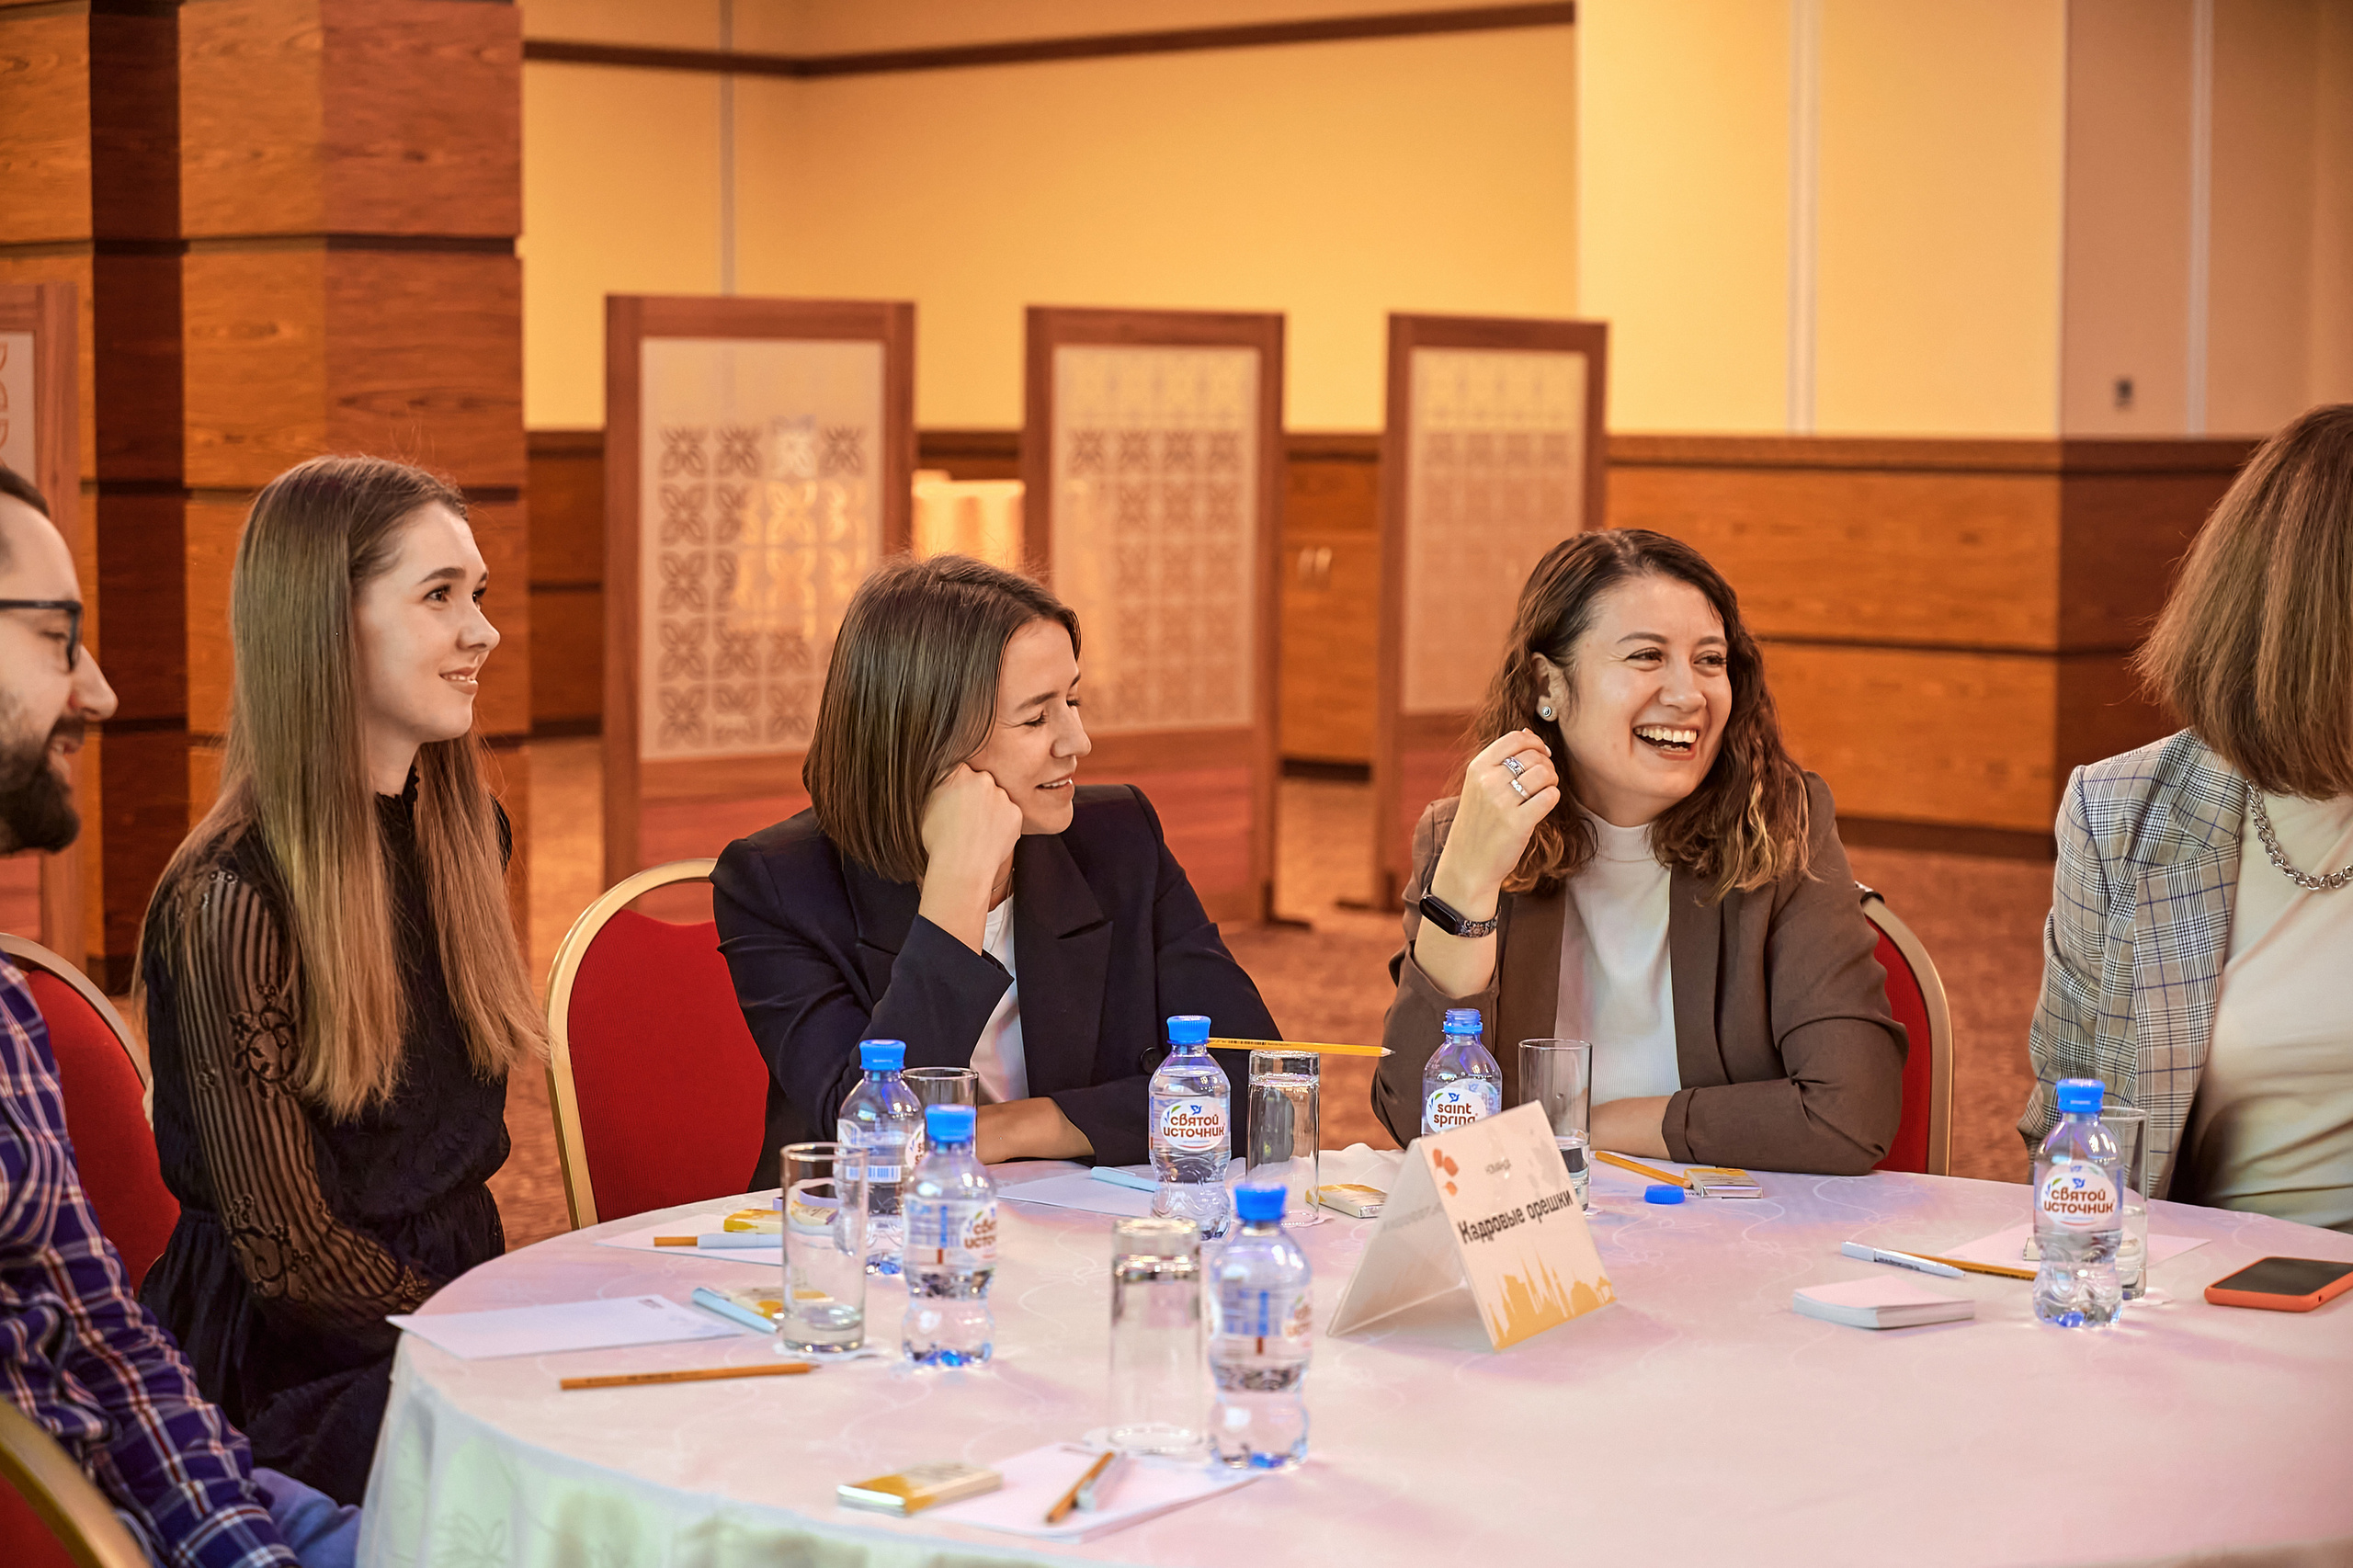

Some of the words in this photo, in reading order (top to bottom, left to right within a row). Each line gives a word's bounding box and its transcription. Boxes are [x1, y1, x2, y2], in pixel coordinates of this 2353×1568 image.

[1438, 1103, 1472, 1114] saint
[1457, 1207, 1526, 1244] Кадровые
[1526, 1189, 1574, 1224] орешки
